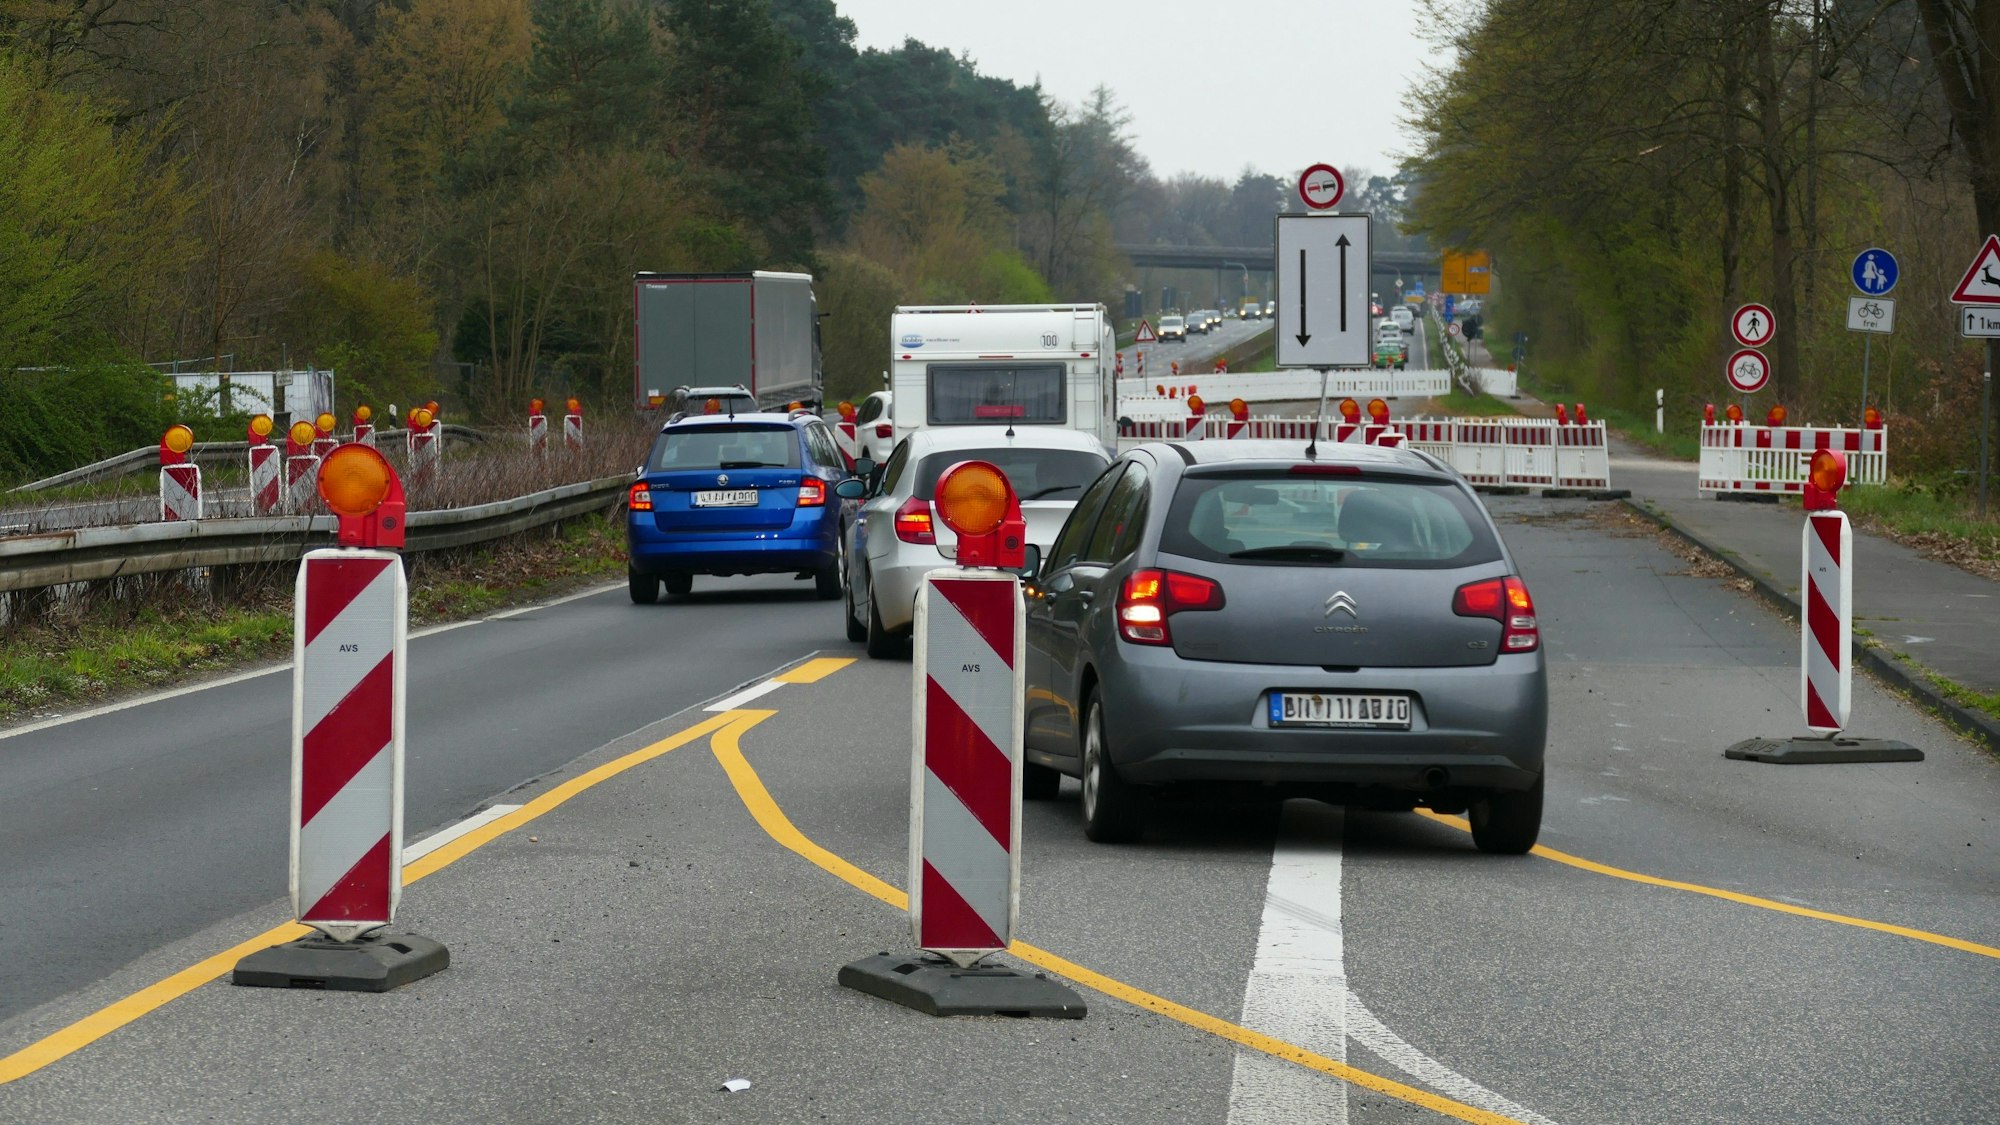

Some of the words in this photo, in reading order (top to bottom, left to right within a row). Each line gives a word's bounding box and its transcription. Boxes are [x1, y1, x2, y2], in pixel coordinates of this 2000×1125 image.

[1863, 320, 1877, 328] frei
[1980, 317, 1984, 330] 1
[1987, 318, 2000, 330] km
[1042, 335, 1057, 347] 100
[339, 644, 359, 652] AVS
[961, 664, 981, 673] AVS
